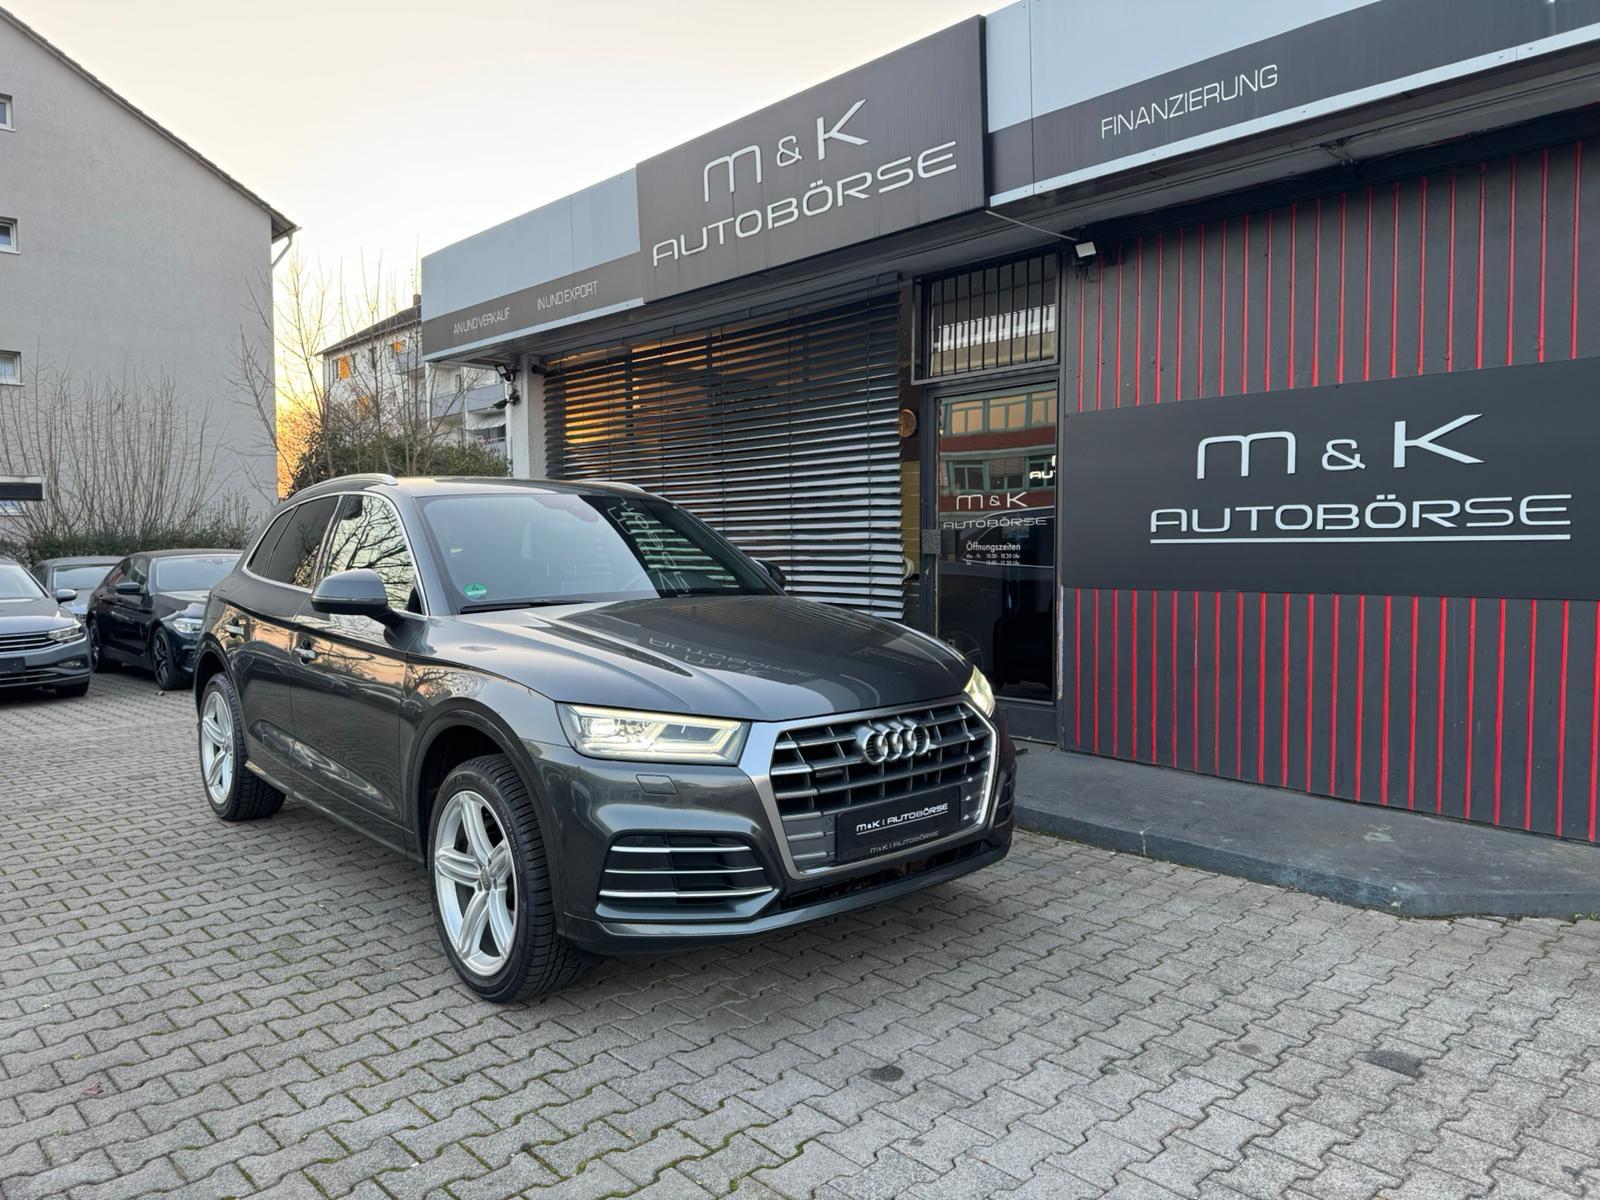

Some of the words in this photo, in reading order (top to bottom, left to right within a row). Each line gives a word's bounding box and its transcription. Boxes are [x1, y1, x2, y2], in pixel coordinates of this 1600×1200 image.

[1101, 64, 1278, 139] FINANZIERUNG
[703, 145, 762, 202] M
[776, 135, 802, 167] &
[816, 99, 870, 161] K
[652, 140, 958, 267] AUTOBÖRSE
[564, 280, 599, 303] EXPORT
[477, 306, 511, 328] VERKAUF
[1196, 430, 1296, 480] M
[1321, 438, 1367, 471] &
[1393, 413, 1486, 469] K
[956, 494, 984, 511] M
[989, 495, 1001, 507] &
[1006, 491, 1028, 508] K
[943, 516, 1048, 530] AUTOBÖRSE
[1150, 493, 1572, 533] AUTOBÖRSE
[966, 540, 1021, 553] Öffnungszeiten
[887, 803, 949, 825] AUTOBÖRSE
